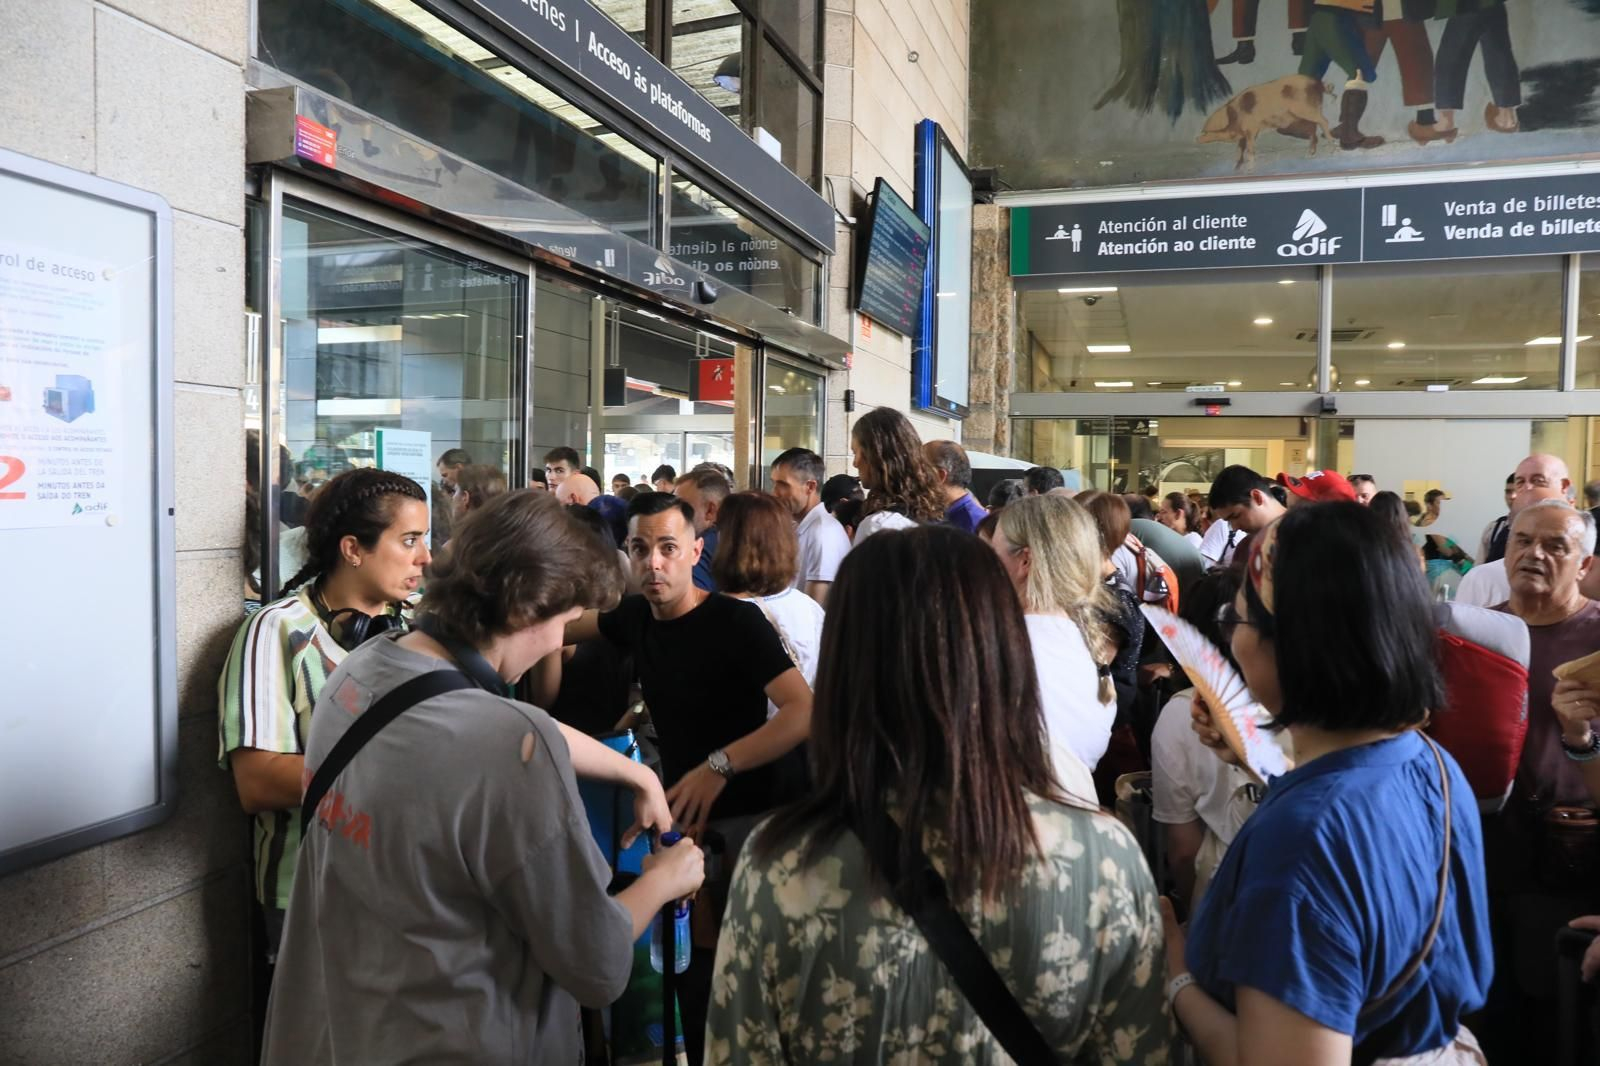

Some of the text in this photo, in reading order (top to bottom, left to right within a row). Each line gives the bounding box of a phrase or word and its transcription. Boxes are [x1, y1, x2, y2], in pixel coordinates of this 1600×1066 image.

[522, 0, 711, 143] enes Acceso ás plataformas
[1444, 200, 1497, 217] Venta
[1503, 197, 1528, 214] de
[1098, 214, 1248, 234] Atención al cliente
[1444, 223, 1504, 241] Venda
[1509, 221, 1535, 237] de
[1097, 236, 1257, 256] Atención ao cliente
[1276, 236, 1343, 257] adif
[26, 257, 45, 272] de
[51, 263, 96, 282] acceso
[84, 502, 108, 511] adif
